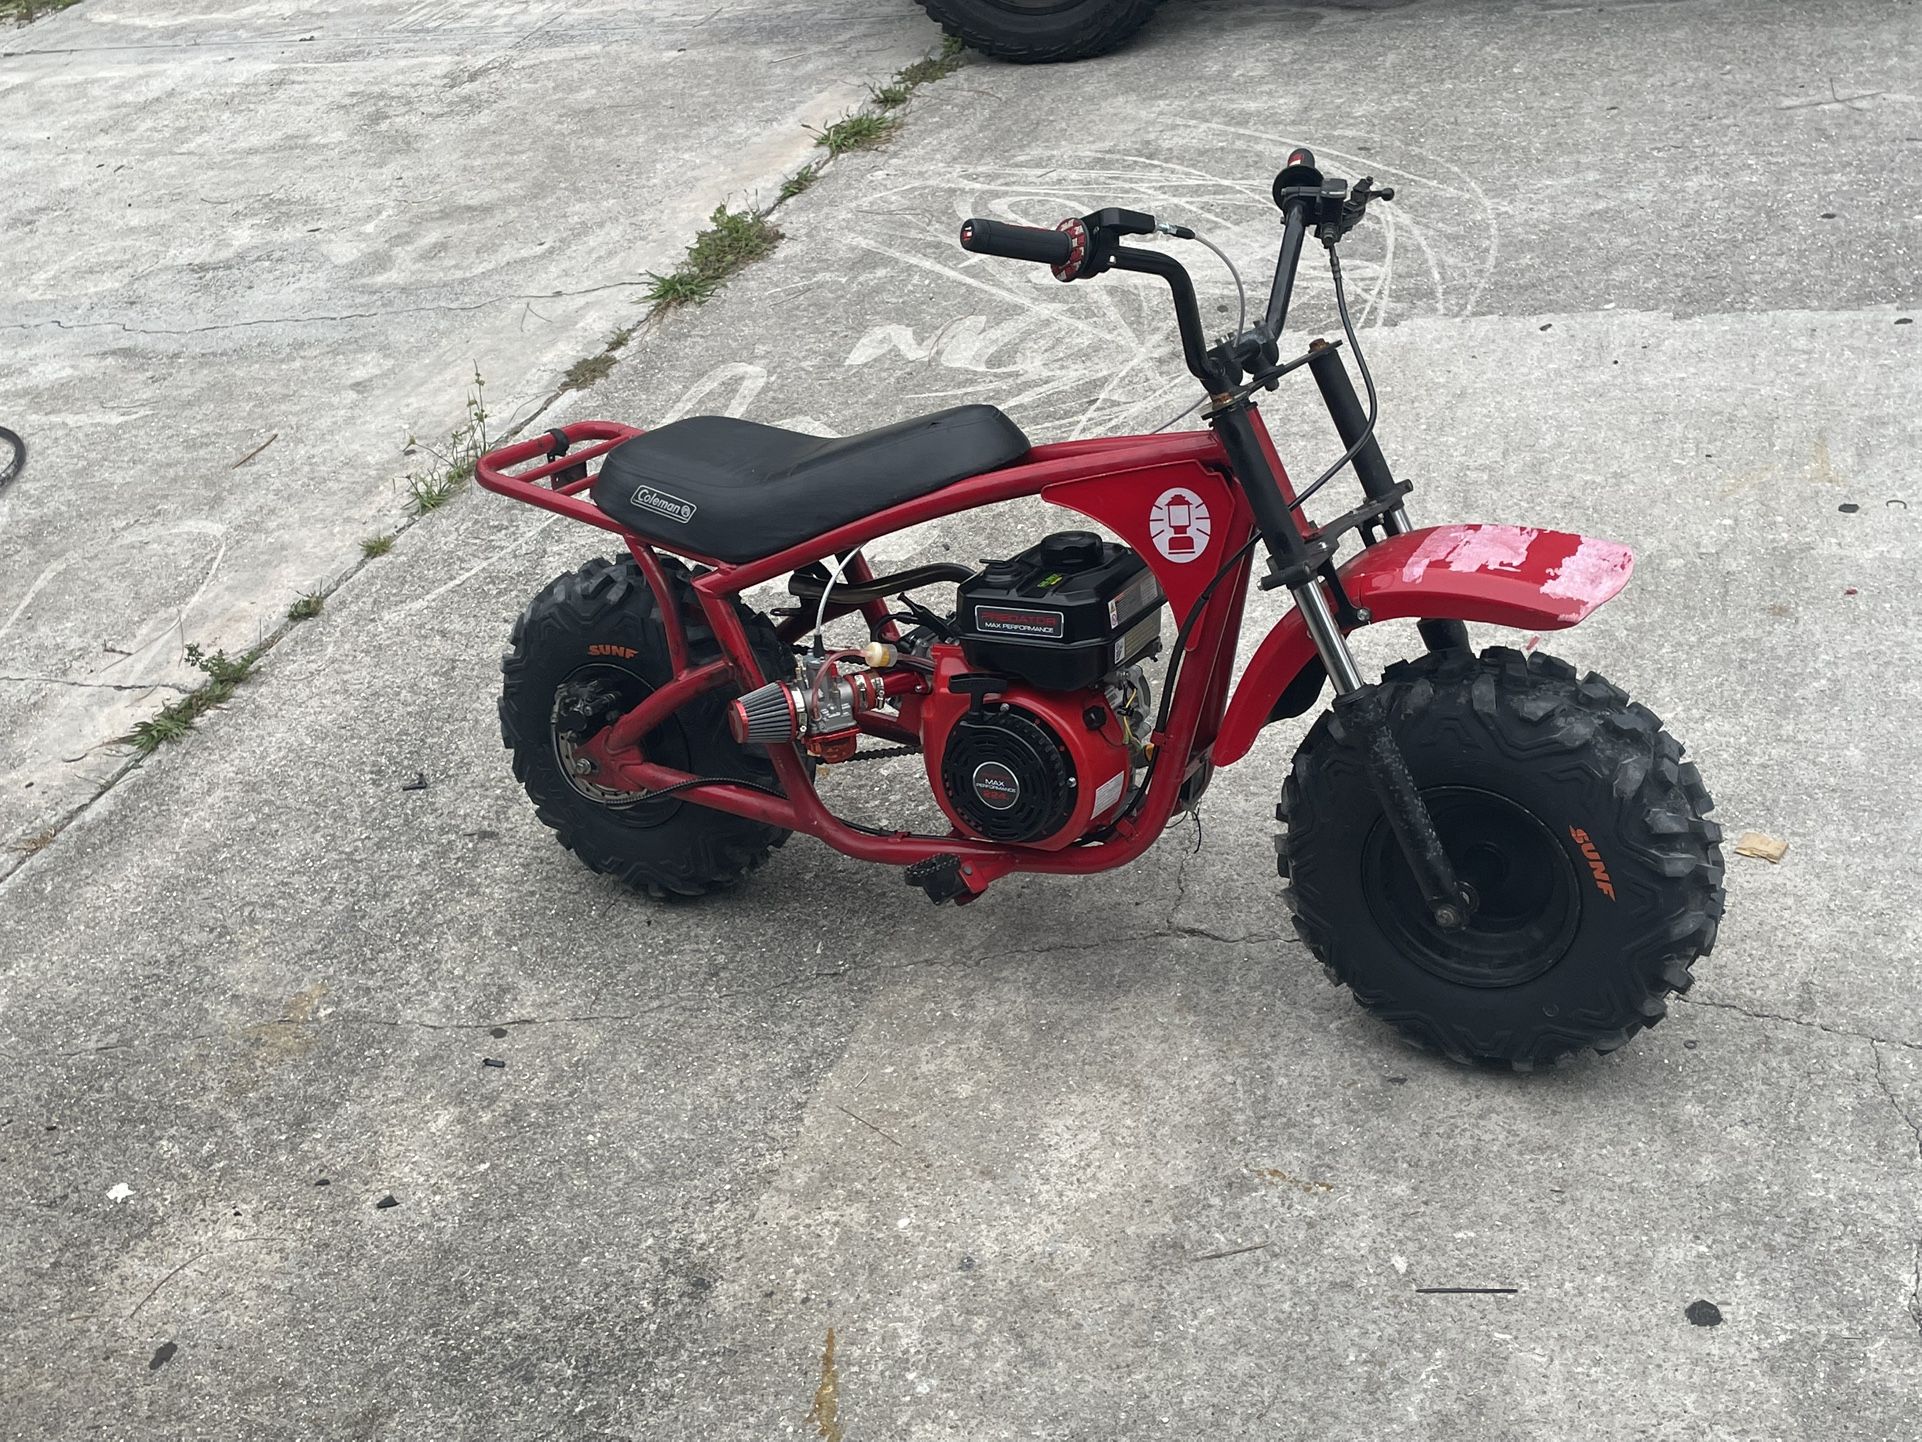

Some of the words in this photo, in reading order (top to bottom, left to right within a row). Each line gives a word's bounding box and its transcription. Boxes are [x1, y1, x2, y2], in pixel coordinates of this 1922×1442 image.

[637, 489, 681, 514] Coleman
[1003, 623, 1054, 633] PERFORMANCE
[587, 645, 639, 659] SUNF
[985, 778, 1005, 787] MAX
[1569, 824, 1616, 902] SUNF
